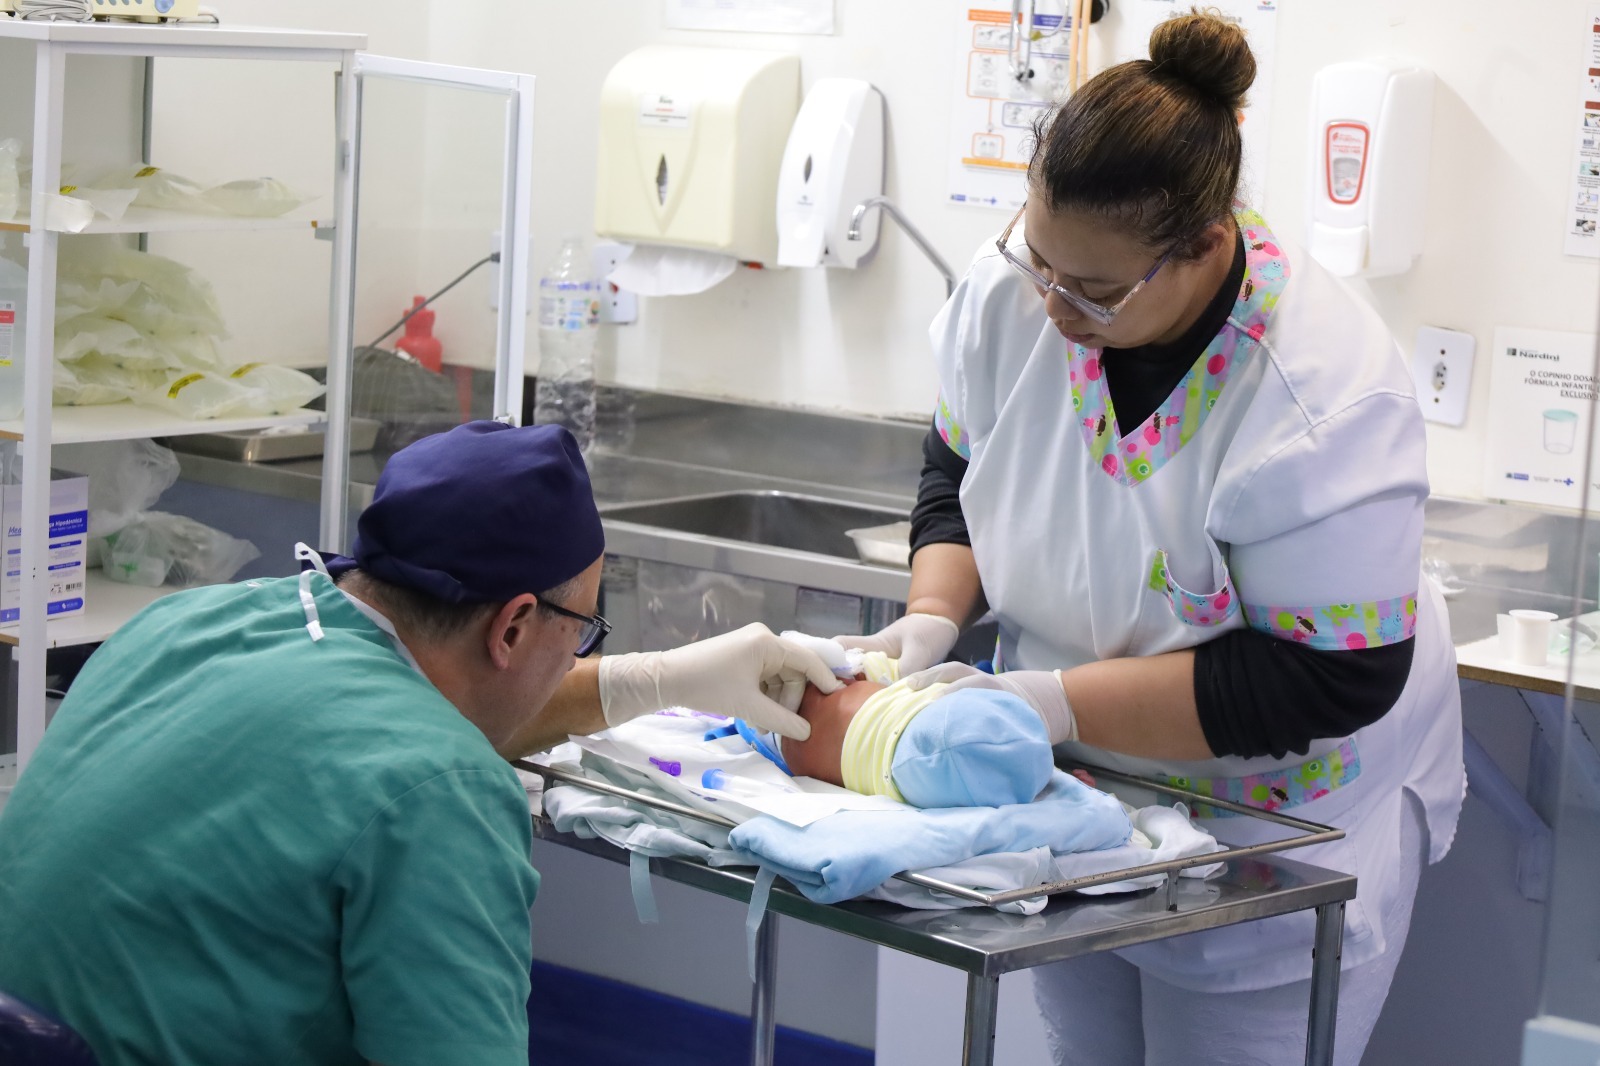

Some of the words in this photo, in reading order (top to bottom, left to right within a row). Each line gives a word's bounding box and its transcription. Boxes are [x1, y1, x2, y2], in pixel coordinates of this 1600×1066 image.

[1519, 351, 1560, 361] Nardini
[1538, 370, 1572, 381] COPINHO
[1524, 377, 1559, 387] FÓRMULA
